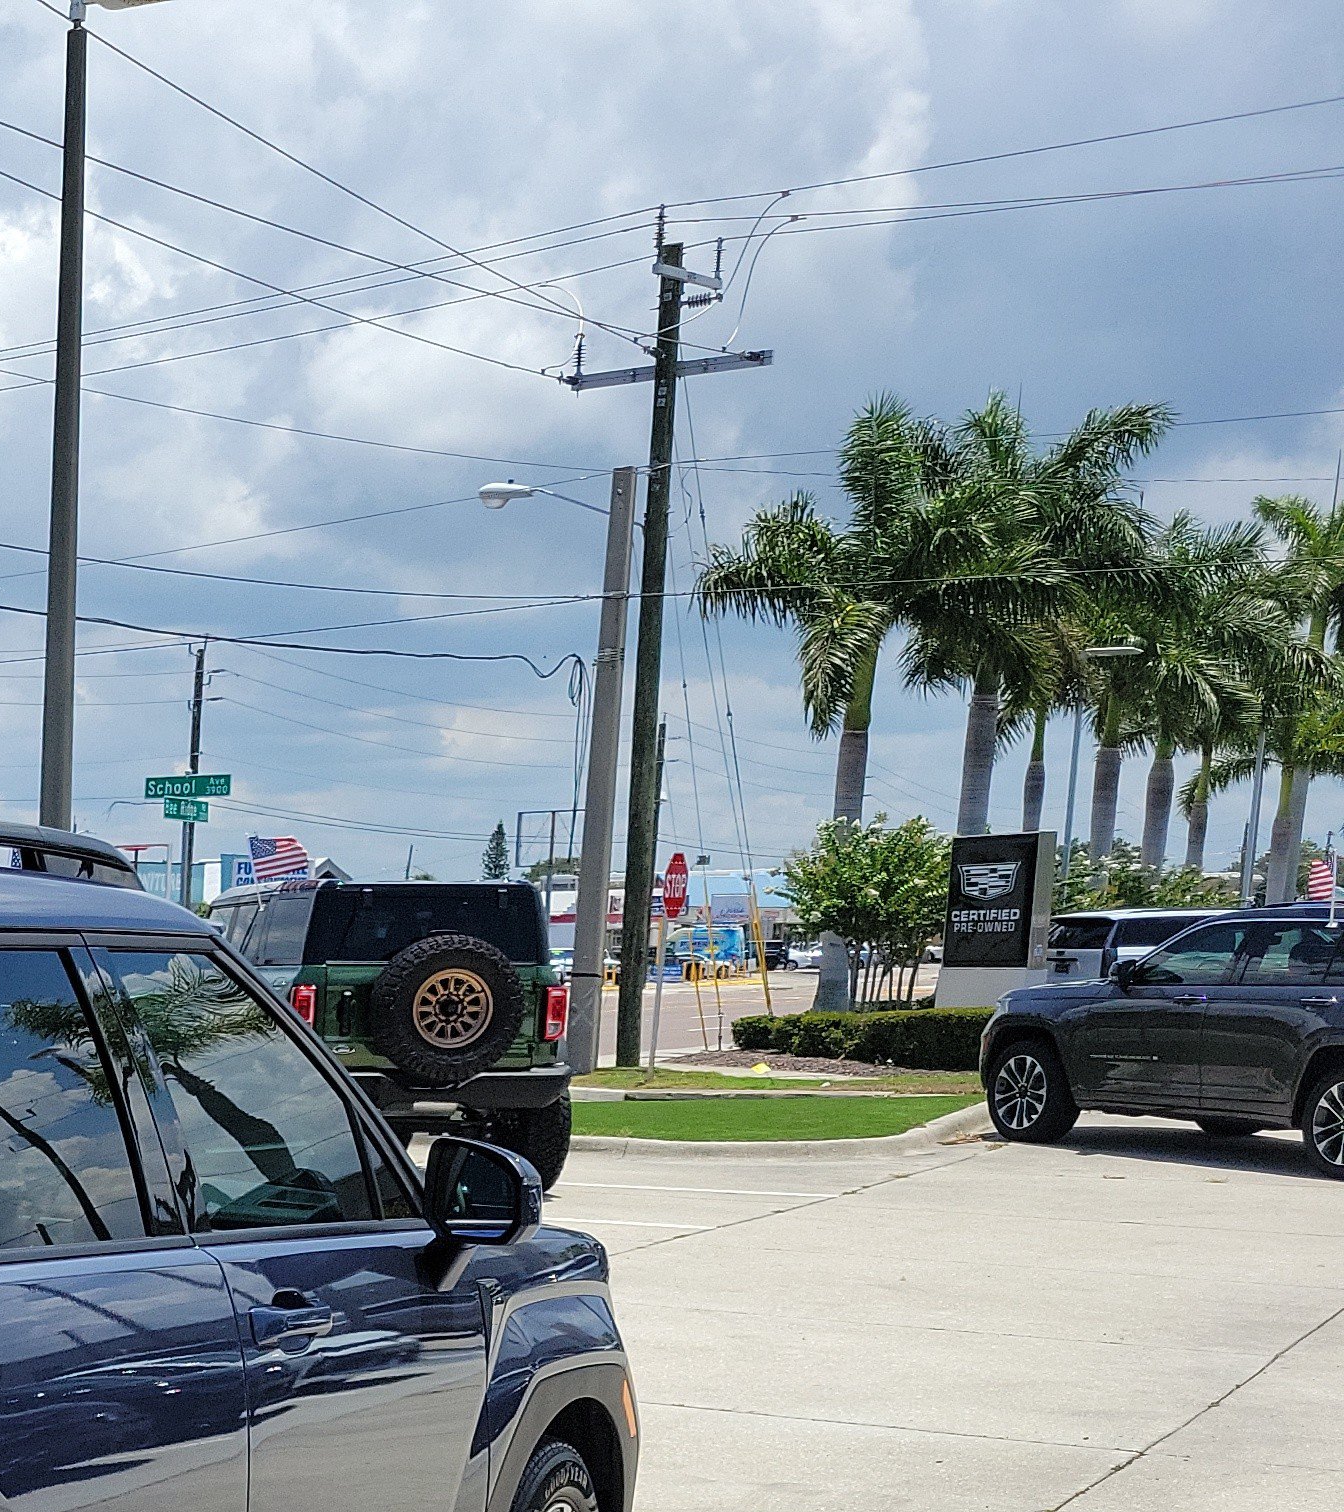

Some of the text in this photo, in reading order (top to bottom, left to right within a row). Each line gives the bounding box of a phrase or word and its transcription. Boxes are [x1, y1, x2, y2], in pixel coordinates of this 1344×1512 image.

[147, 777, 225, 796] School Ave
[206, 785, 228, 795] 3900
[664, 873, 687, 898] STOP
[951, 908, 1020, 922] CERTIFIED
[953, 921, 1015, 933] PRE-OWNED
